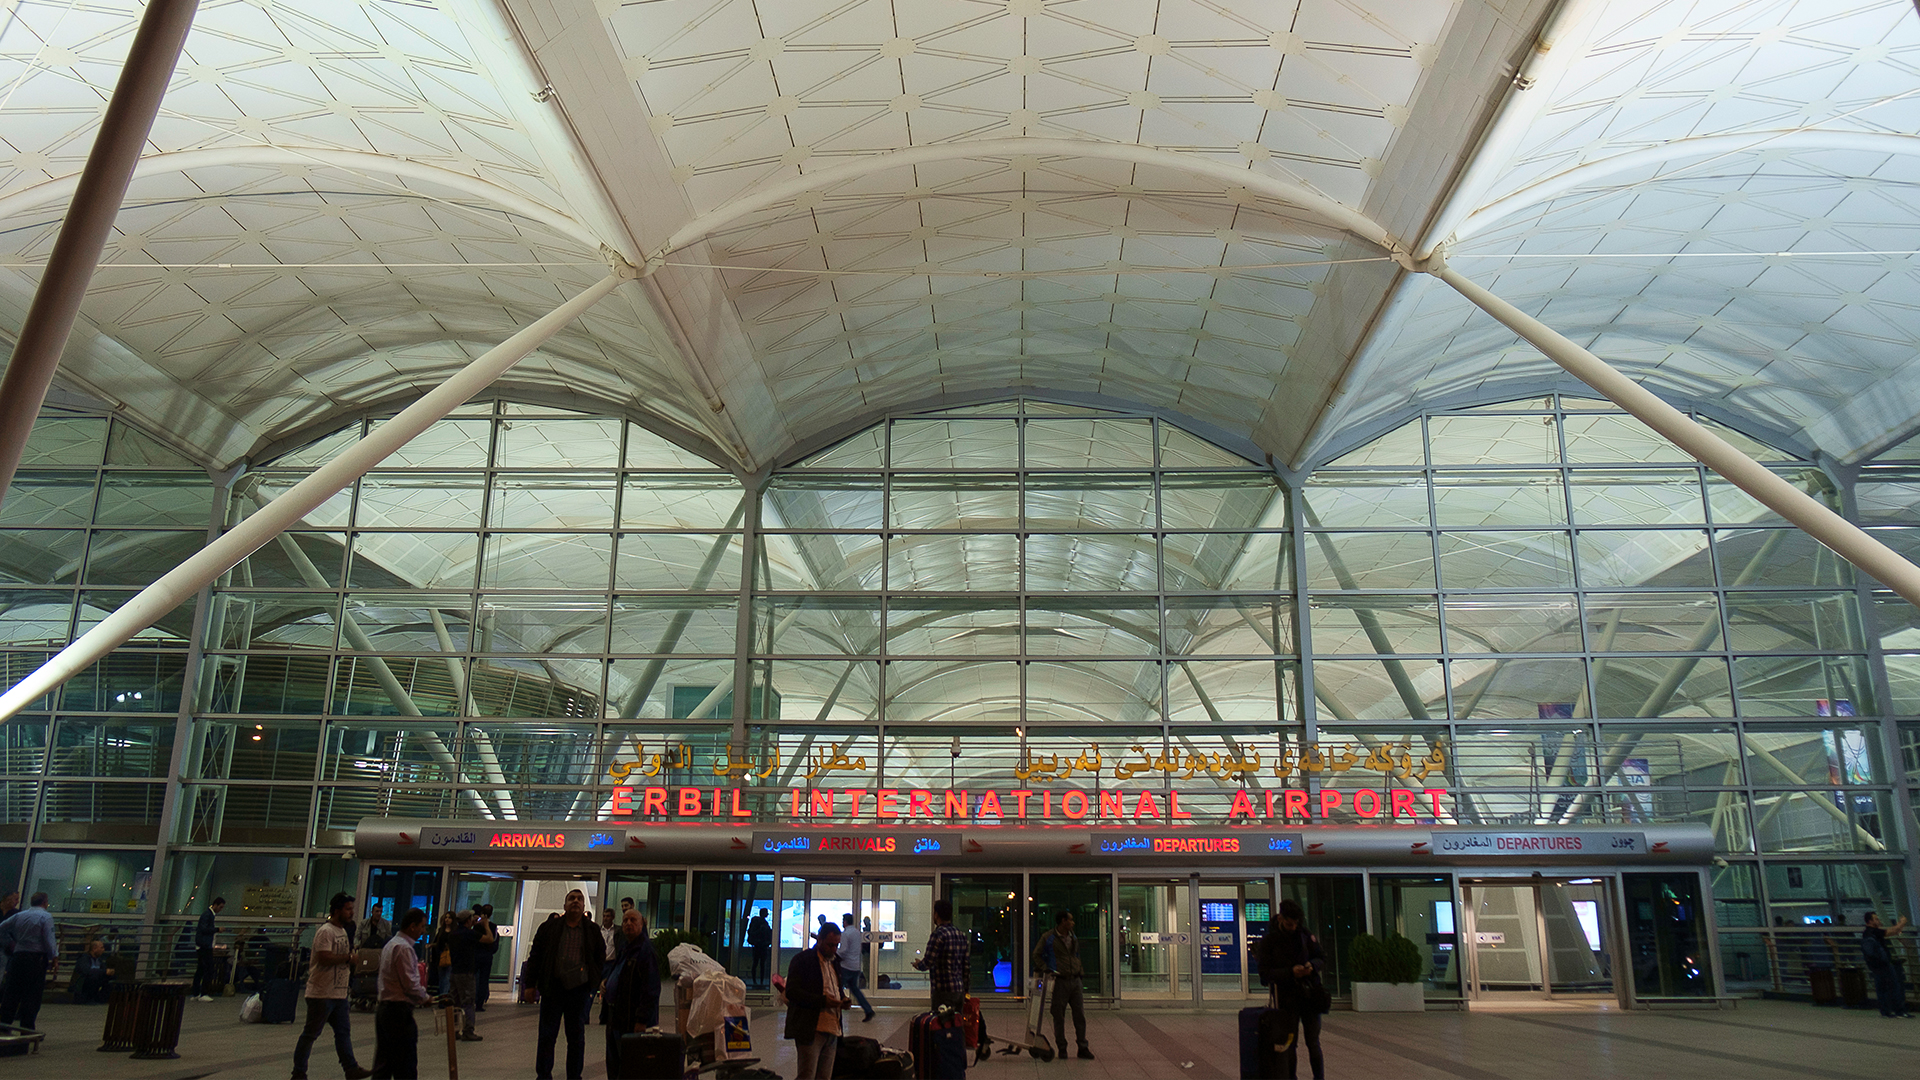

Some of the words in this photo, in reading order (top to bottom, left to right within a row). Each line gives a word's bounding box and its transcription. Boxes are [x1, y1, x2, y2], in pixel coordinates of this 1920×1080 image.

[609, 742, 692, 786] الدولي
[800, 743, 867, 779] مطار
[611, 787, 752, 816] ERBIL
[792, 788, 1192, 819] INTERNATIONAL
[1229, 788, 1448, 818] AIRPORT
[431, 832, 476, 847] القادمون
[489, 833, 566, 848] ARRIVALS
[763, 837, 810, 853] القادمون
[818, 837, 897, 852] ARRIVALS
[1100, 837, 1150, 852] المغادرون
[1154, 838, 1240, 853] DEPARTURES
[1442, 836, 1493, 851] المغادرون
[1497, 837, 1582, 850] DEPARTURES
